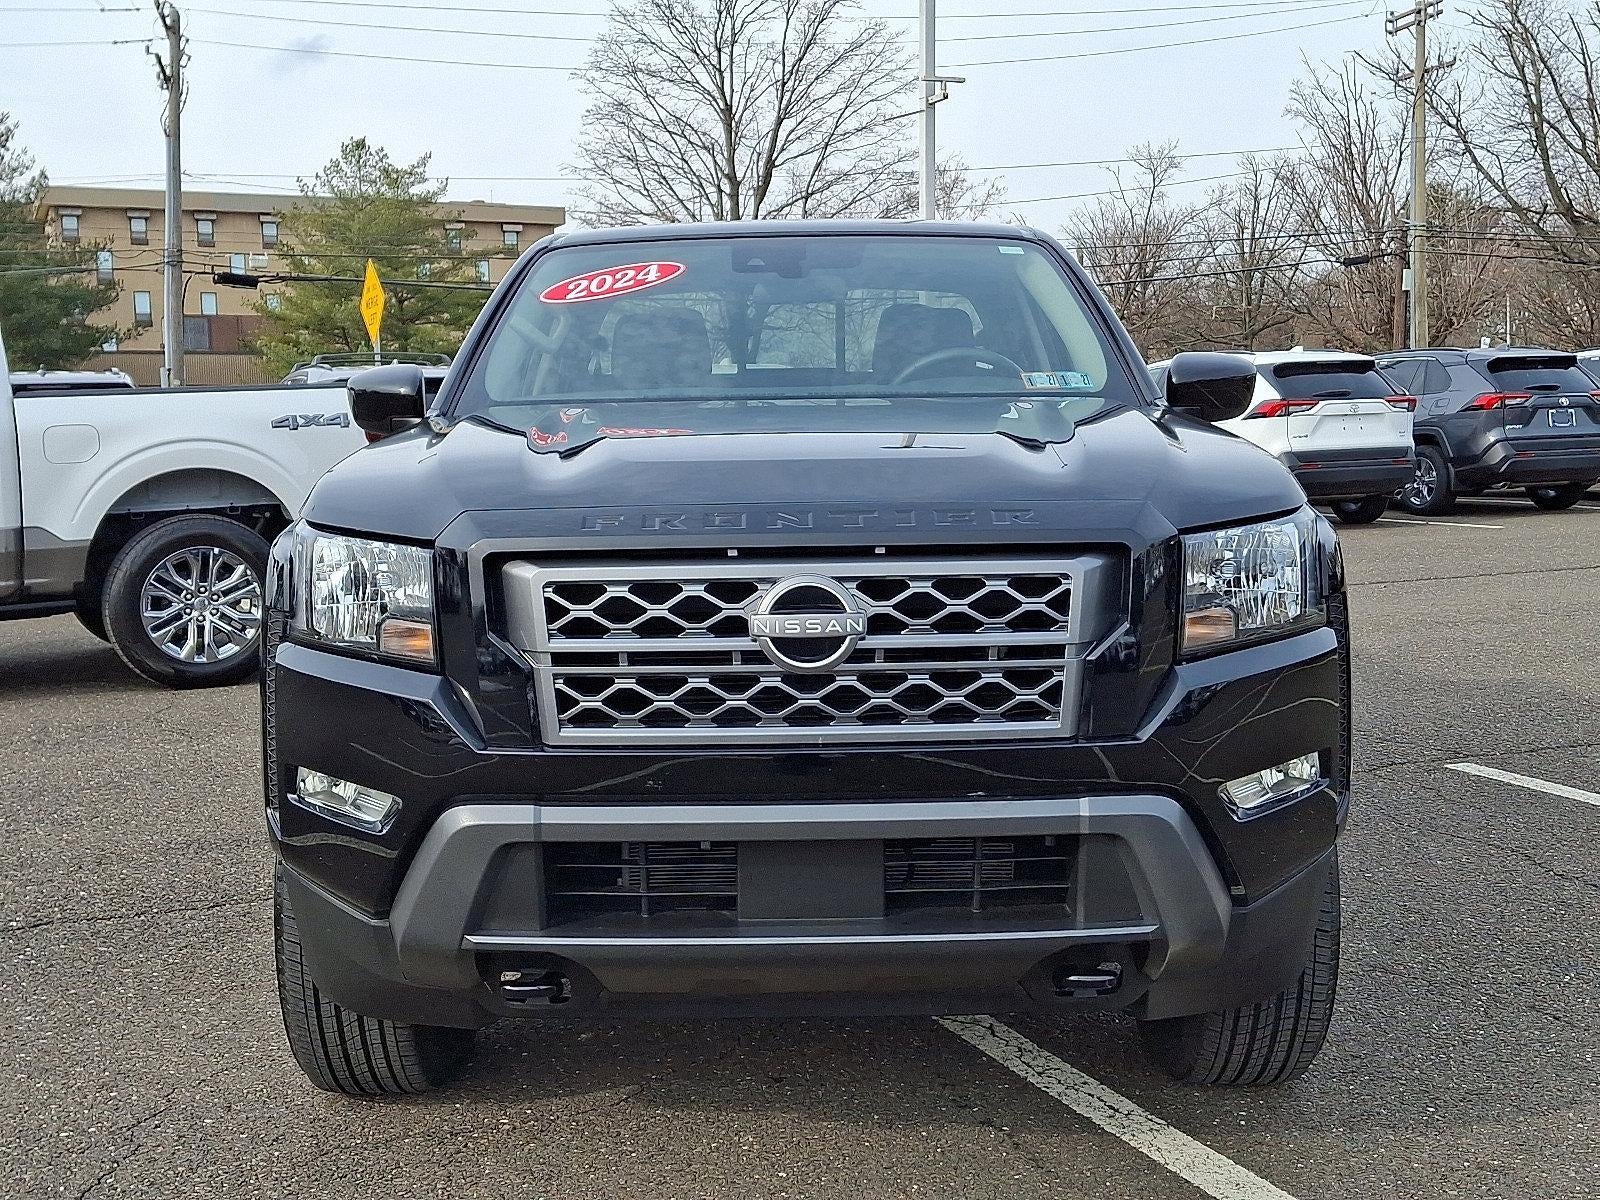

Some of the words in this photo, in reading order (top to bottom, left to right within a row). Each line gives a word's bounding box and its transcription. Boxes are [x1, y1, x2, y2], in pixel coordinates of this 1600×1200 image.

[565, 264, 661, 300] 2024
[580, 508, 1040, 531] FRONTIER
[753, 618, 863, 634] NISSAN
